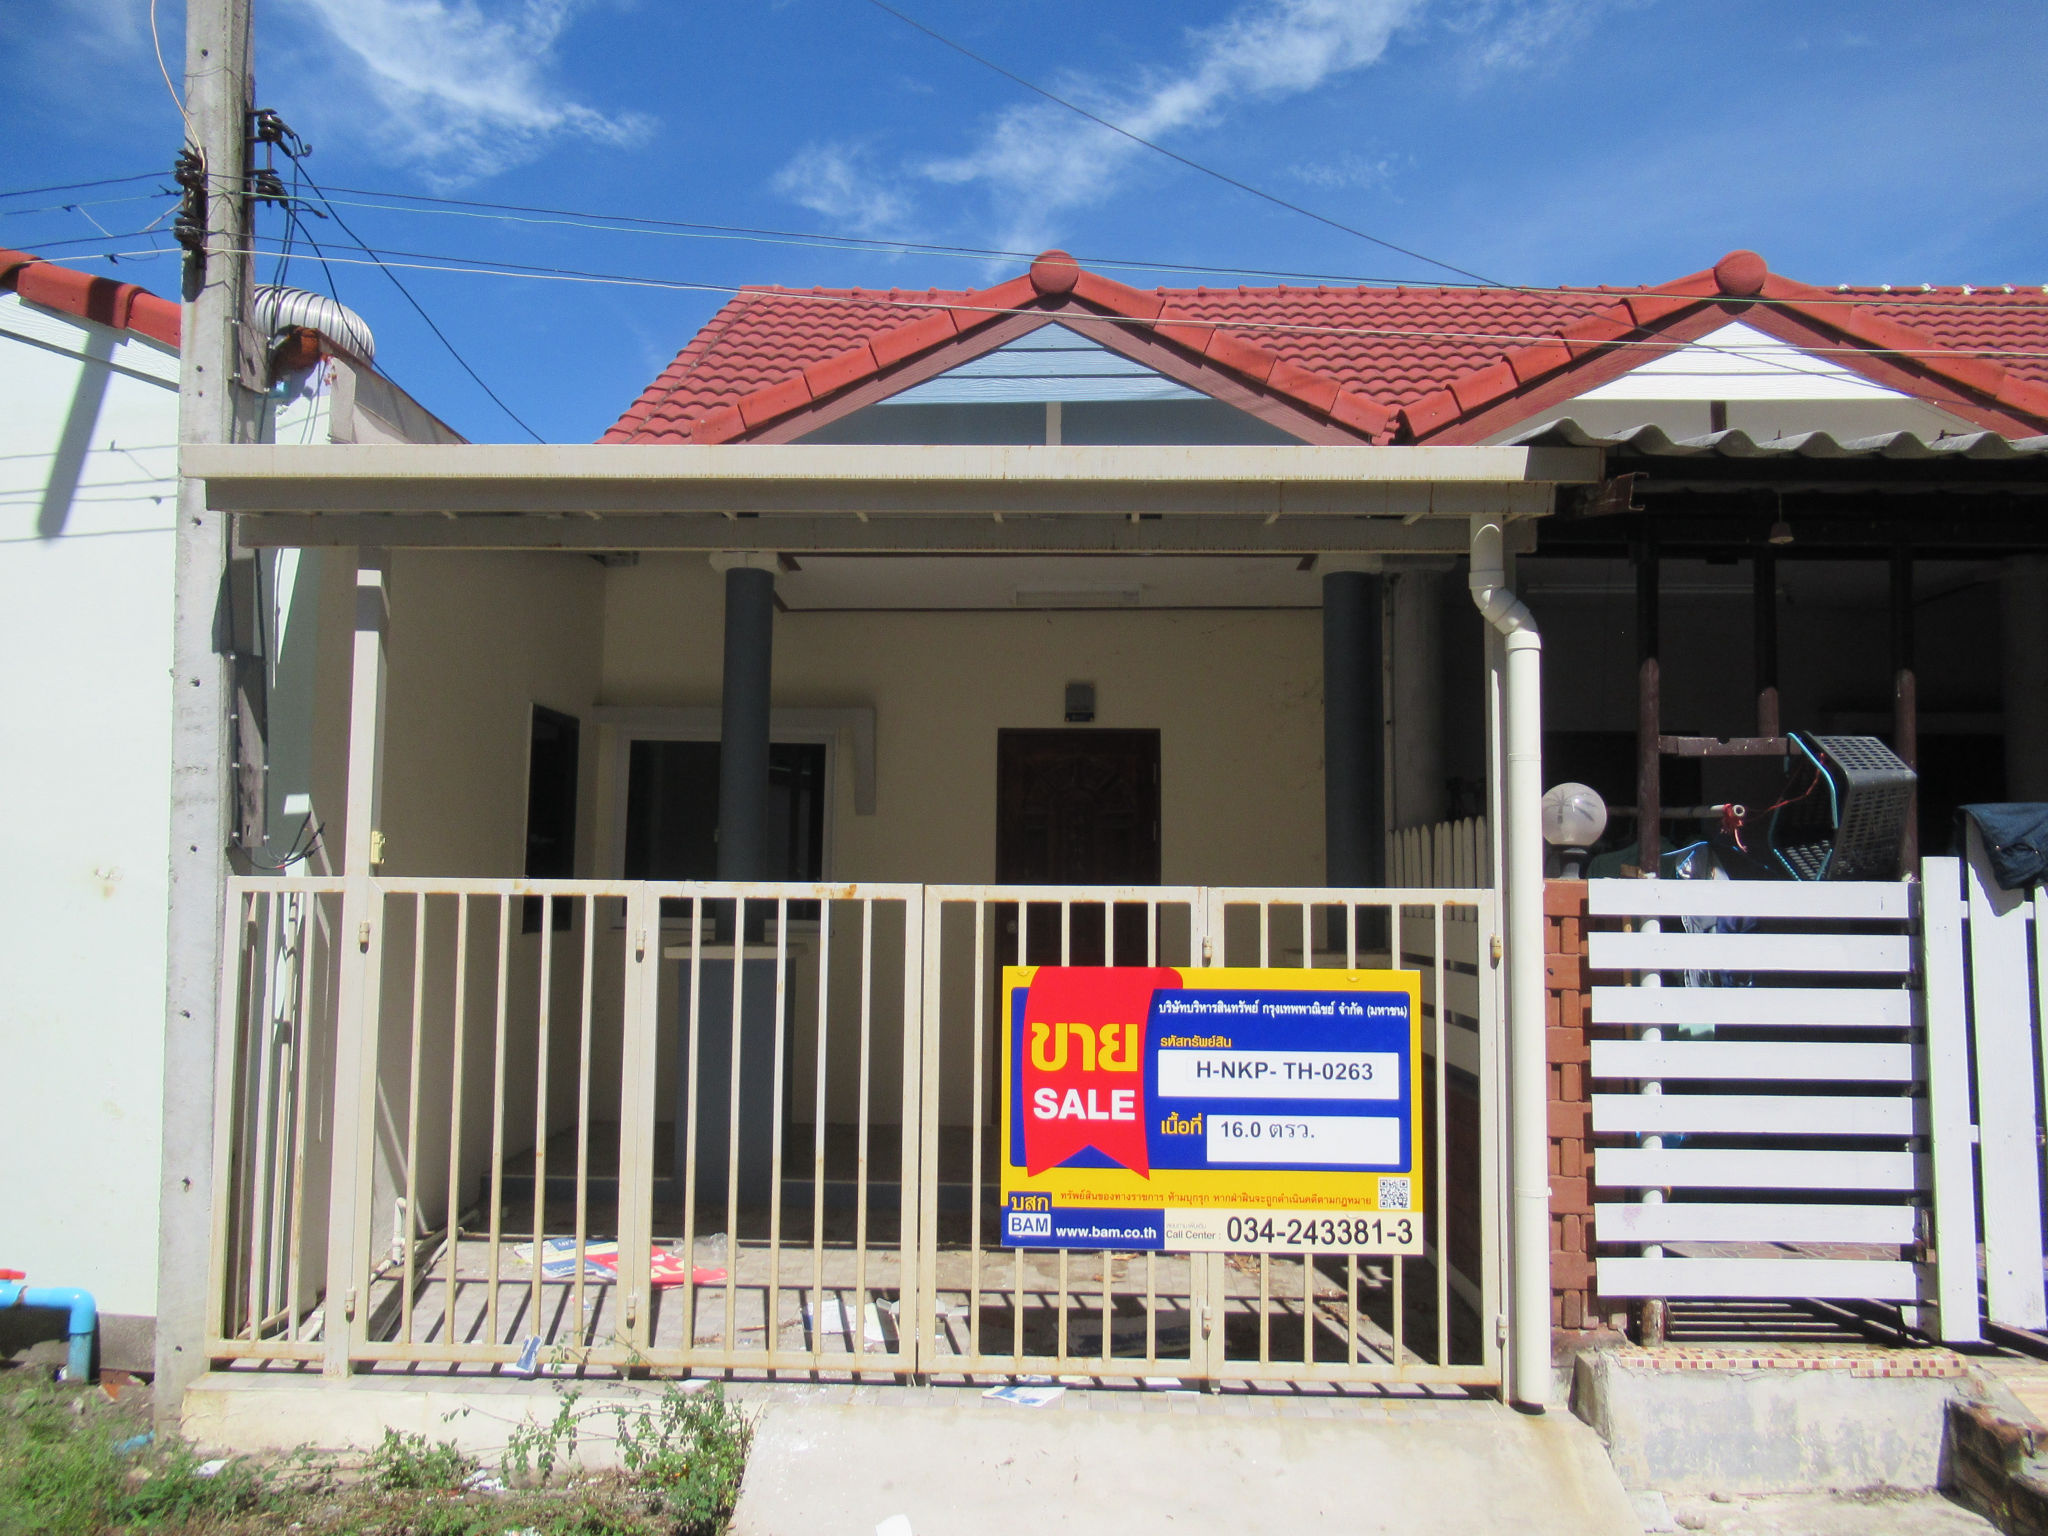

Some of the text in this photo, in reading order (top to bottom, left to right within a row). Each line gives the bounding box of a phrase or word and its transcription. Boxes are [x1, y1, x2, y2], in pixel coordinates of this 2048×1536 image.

[1158, 999, 1408, 1019] บริษัทบริหารสินทรัพย์ กรุงเทพพาณิชย์ จำกัด (มหาชน)
[1031, 1022, 1138, 1072] ขาย
[1160, 1034, 1232, 1048] รหัสทรัพย์สิน
[1283, 1062, 1374, 1081] TH-0263
[1033, 1087, 1136, 1120] SALE
[1160, 1111, 1202, 1135] เนื้อที่
[1220, 1121, 1315, 1139] 16.0 ตรว.
[1011, 1195, 1049, 1211] บสก
[1168, 1191, 1209, 1206] ห้ามบุกรุก
[1011, 1217, 1048, 1233] BAM
[1056, 1225, 1157, 1239] www.bam.co.th
[1166, 1229, 1183, 1239] Call
[1226, 1215, 1413, 1245] 034-243381-3
